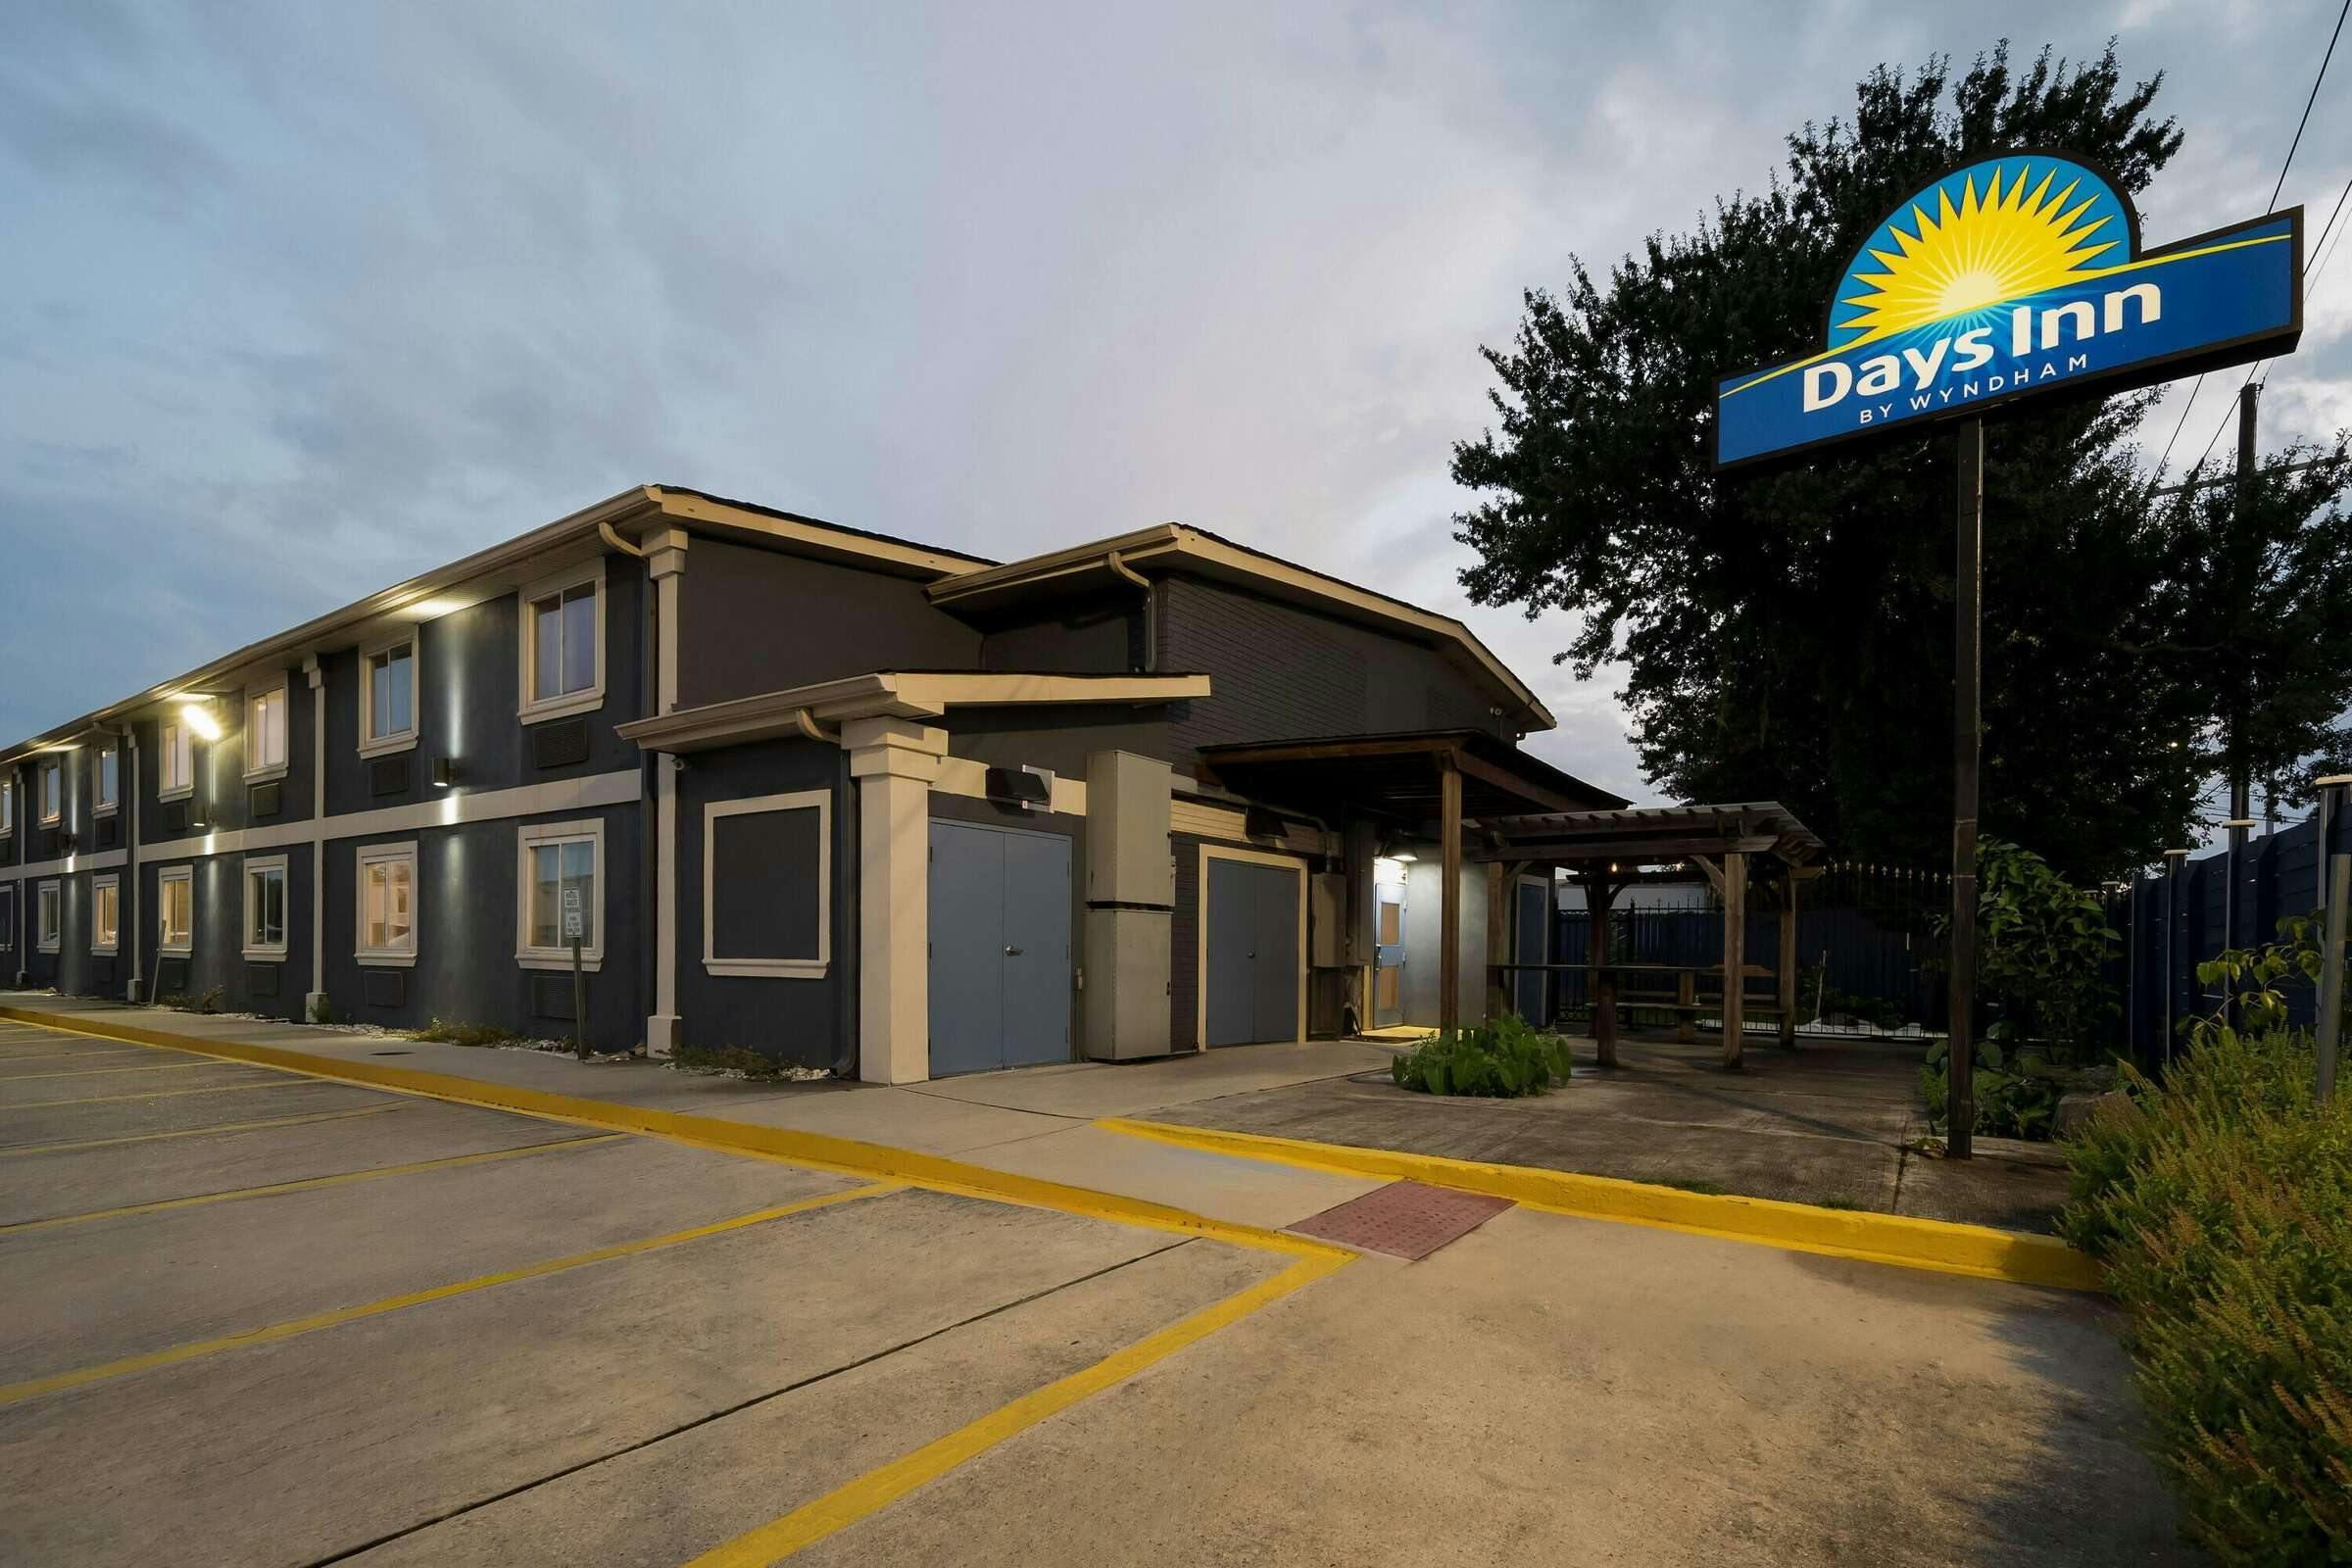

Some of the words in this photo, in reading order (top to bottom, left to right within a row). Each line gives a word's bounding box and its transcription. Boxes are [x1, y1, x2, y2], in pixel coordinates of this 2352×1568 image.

[1802, 326, 1995, 413] Days
[2012, 282, 2162, 358] Inn
[1859, 403, 1893, 425] BY
[1909, 353, 2088, 412] WYNDHAM
